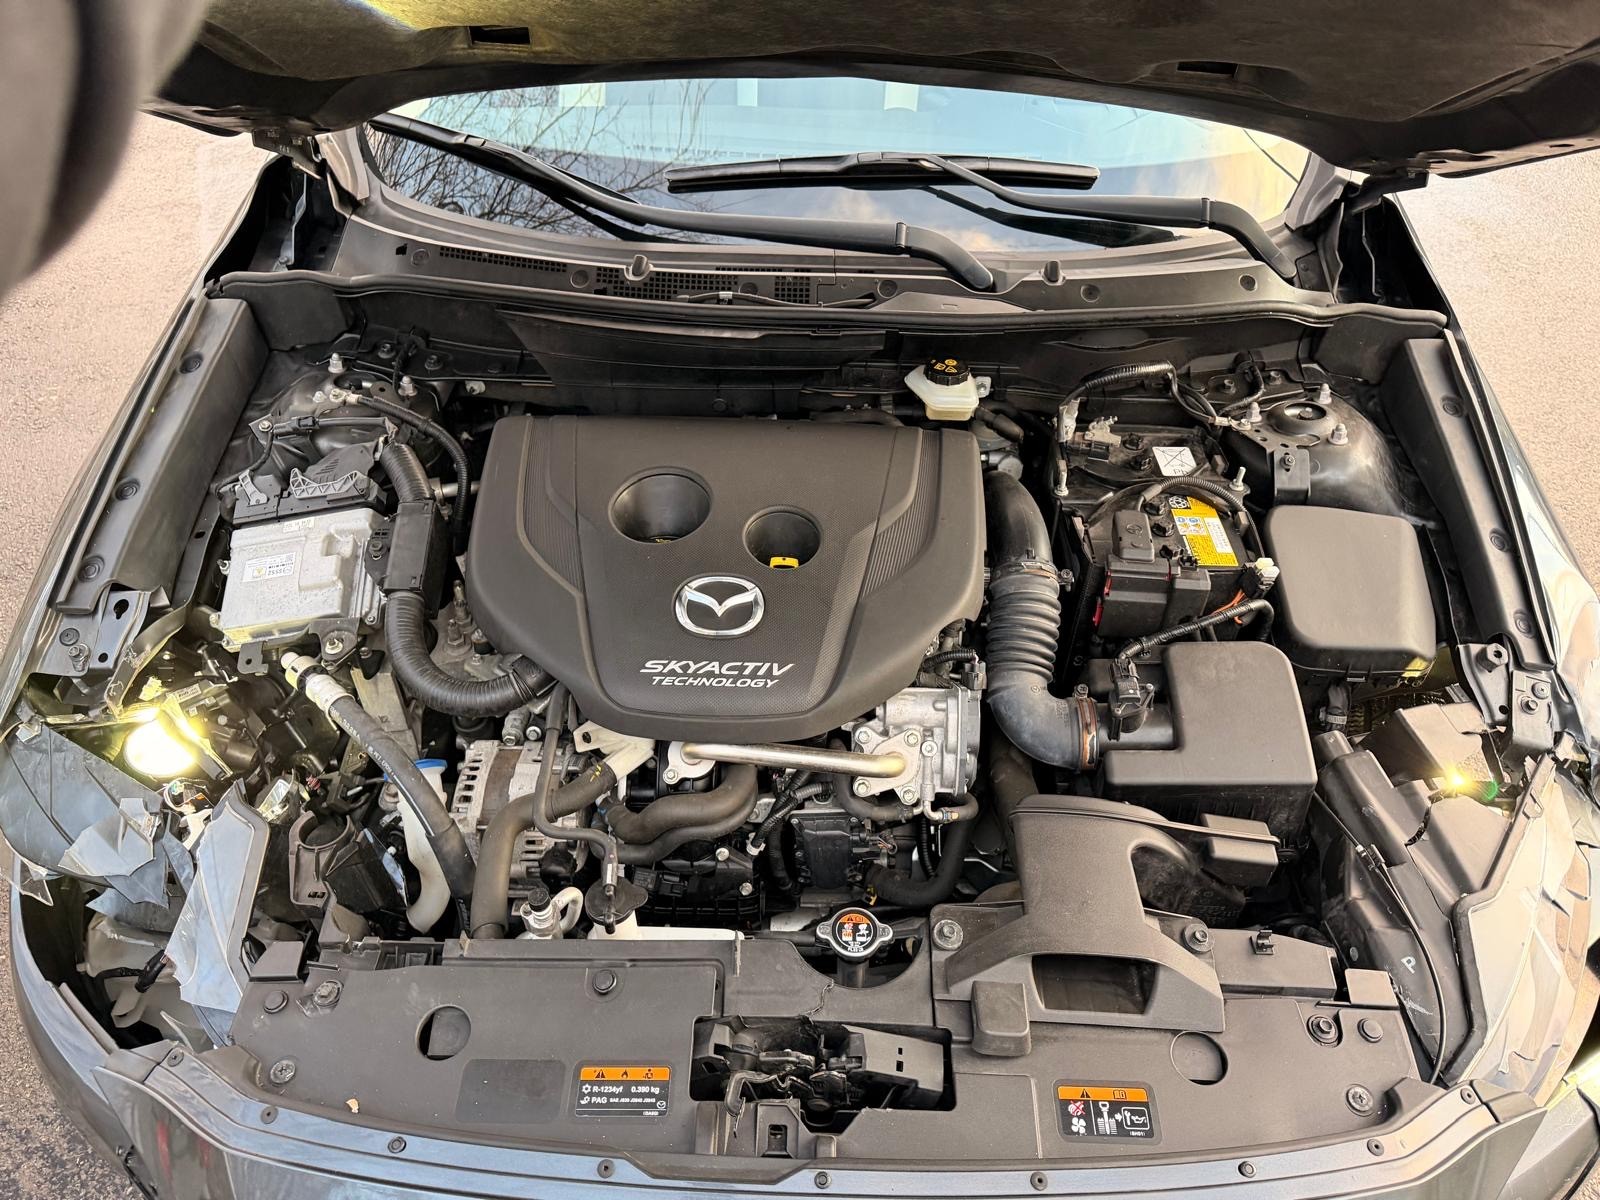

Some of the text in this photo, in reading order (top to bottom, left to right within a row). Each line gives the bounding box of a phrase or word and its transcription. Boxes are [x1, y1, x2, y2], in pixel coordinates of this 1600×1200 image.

[640, 660, 795, 676] SKYACTIV
[652, 677, 779, 688] TECHNOLOGY
[592, 1086, 623, 1094] R-1234yf
[650, 1086, 660, 1094] kg
[591, 1096, 608, 1104] PAG
